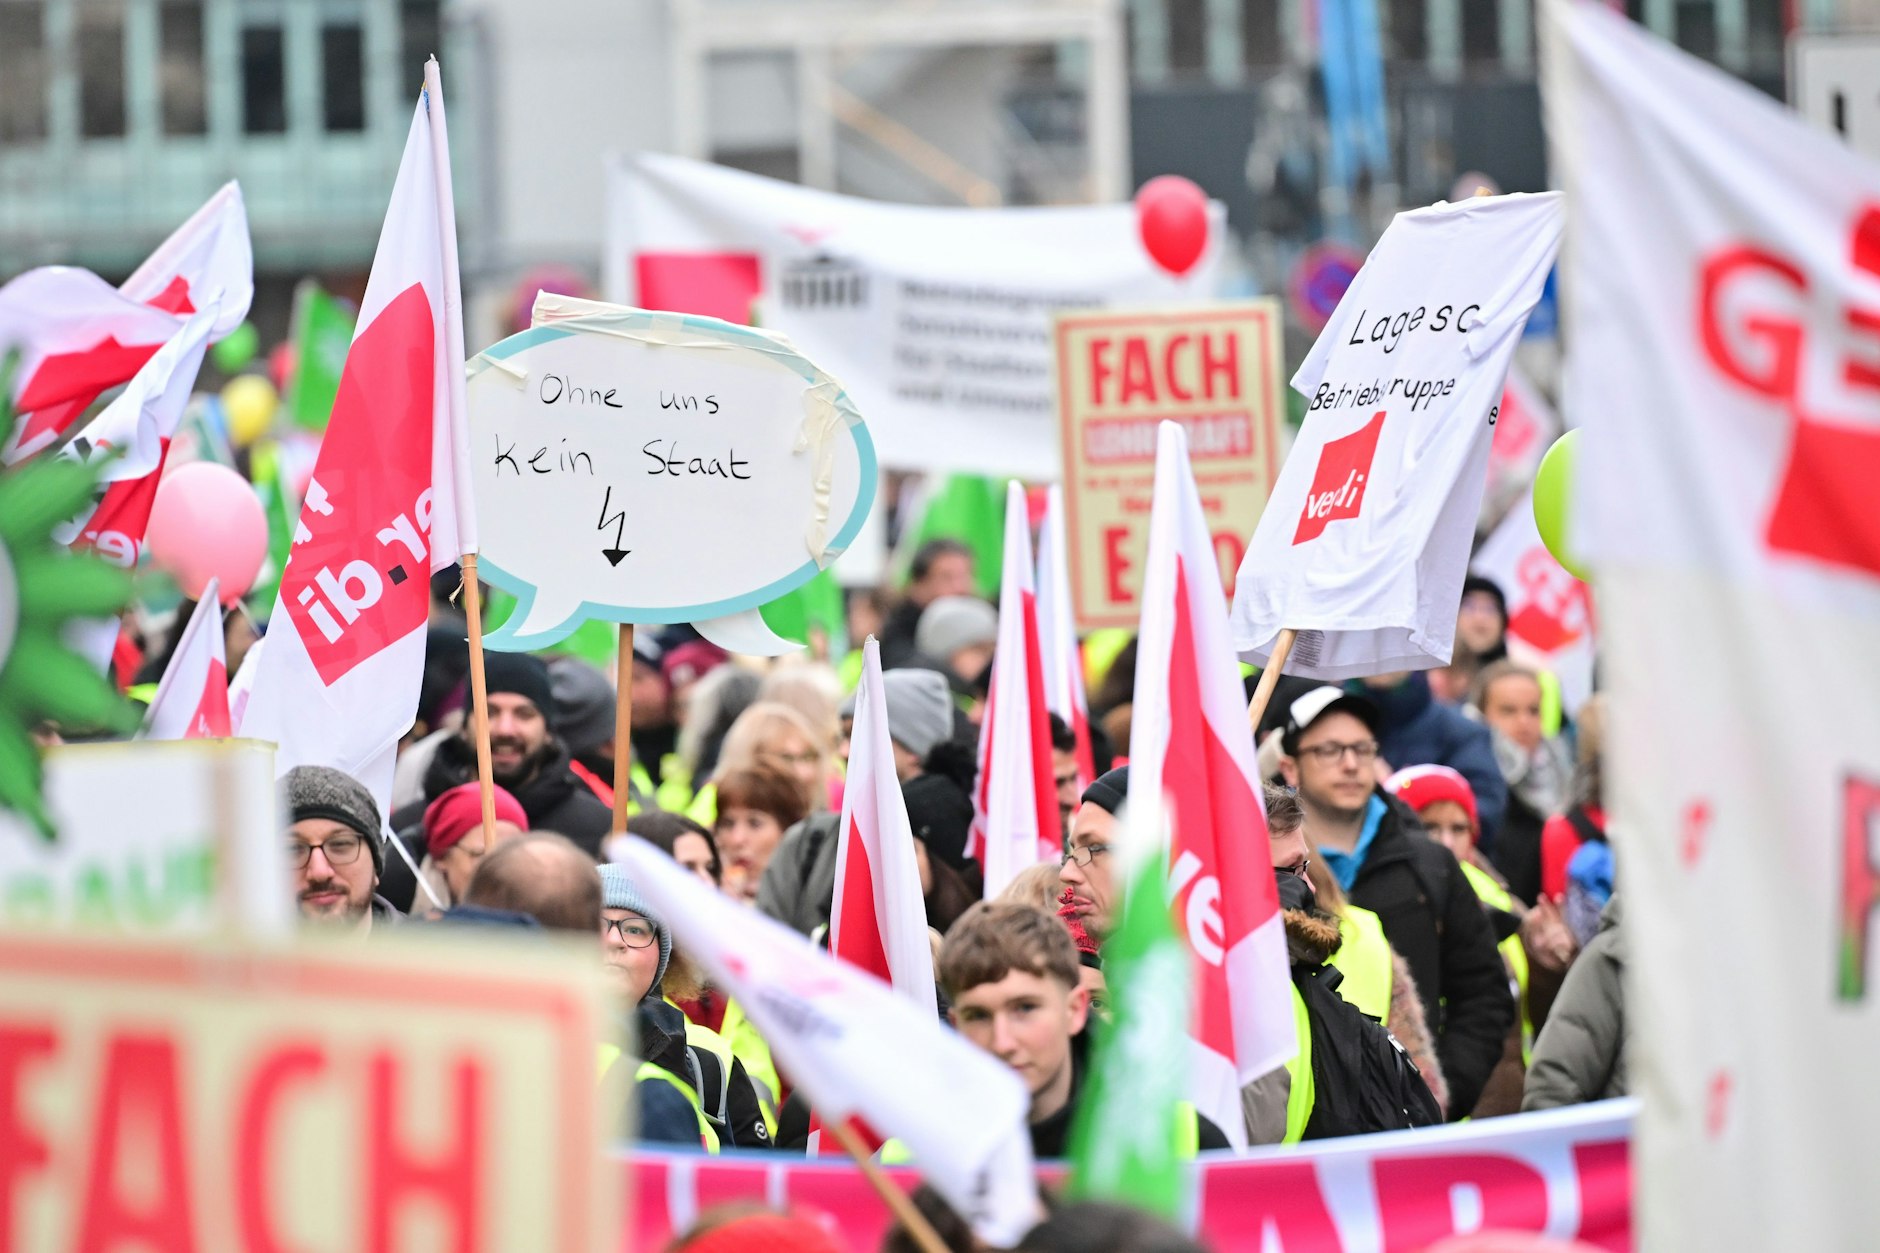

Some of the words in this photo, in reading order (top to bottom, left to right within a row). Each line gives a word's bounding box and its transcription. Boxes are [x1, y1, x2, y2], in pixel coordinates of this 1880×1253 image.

[1088, 332, 1241, 405] FACH
[539, 373, 624, 408] Ohne
[659, 390, 720, 415] uns
[642, 438, 752, 480] Staat
